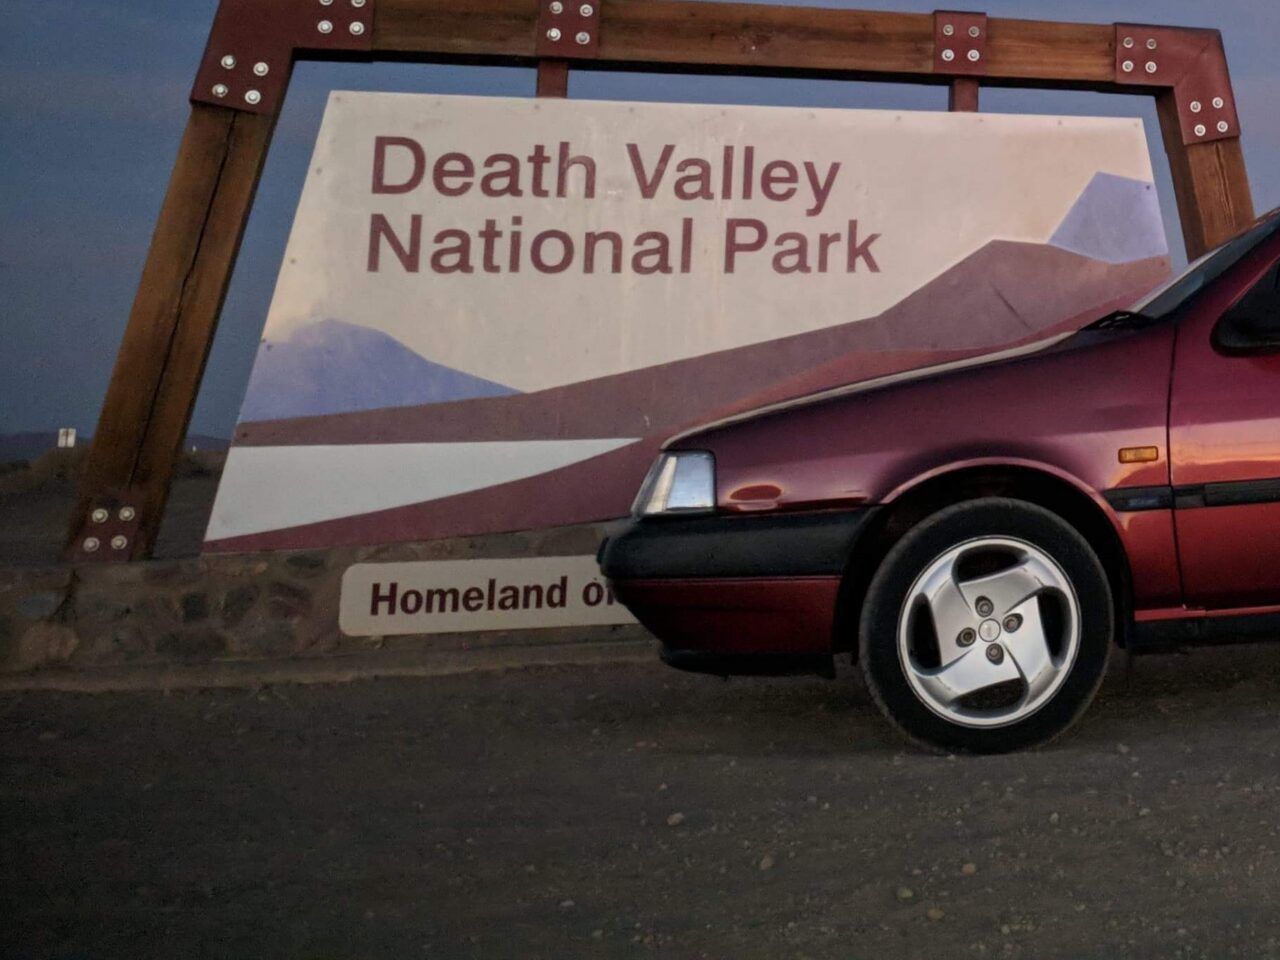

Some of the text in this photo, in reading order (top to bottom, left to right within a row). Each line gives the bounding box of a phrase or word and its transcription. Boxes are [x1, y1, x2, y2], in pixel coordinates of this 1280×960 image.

[371, 135, 841, 217] Death Valley
[366, 213, 881, 275] National Park
[370, 576, 569, 616] Homeland
